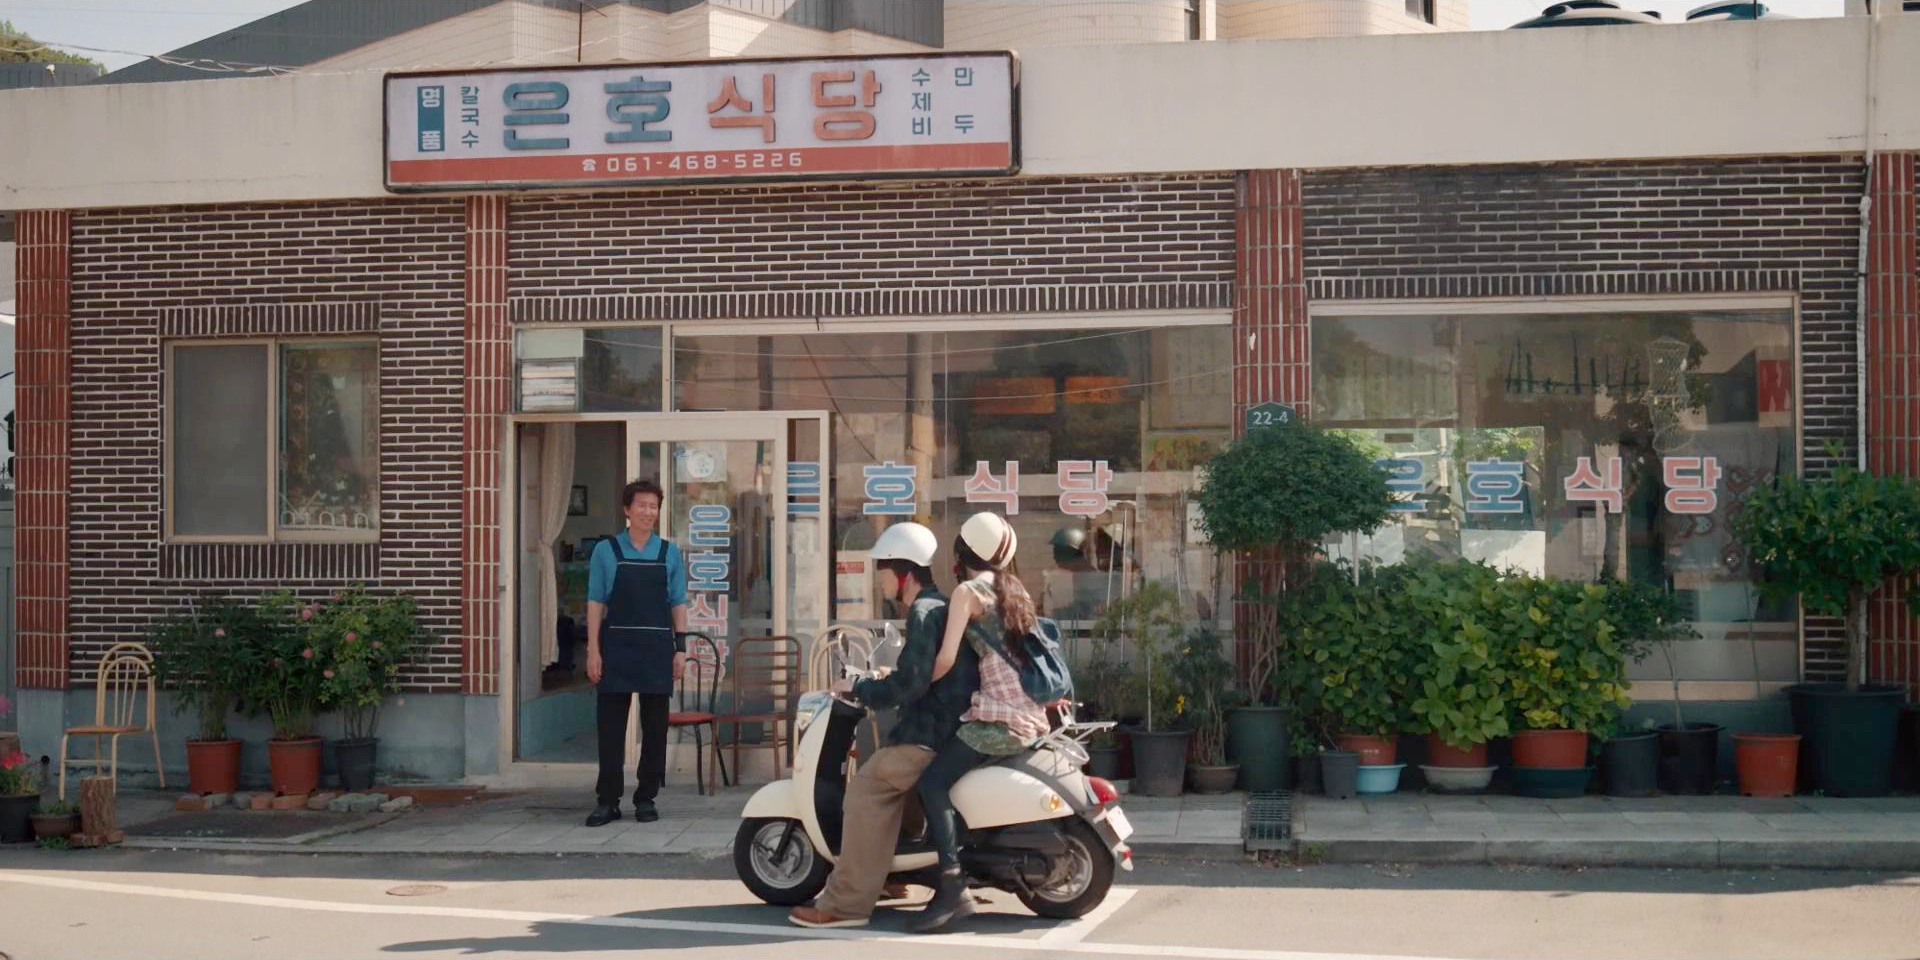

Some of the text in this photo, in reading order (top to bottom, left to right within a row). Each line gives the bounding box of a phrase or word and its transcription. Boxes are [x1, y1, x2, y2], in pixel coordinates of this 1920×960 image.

[422, 88, 441, 150] 명품
[461, 86, 479, 148] 칼국수
[502, 70, 882, 150] 은호식당
[911, 67, 931, 136] 수제비
[954, 67, 975, 134] 만두
[607, 152, 802, 172] 061-468-5226
[1253, 411, 1289, 425] 22-4
